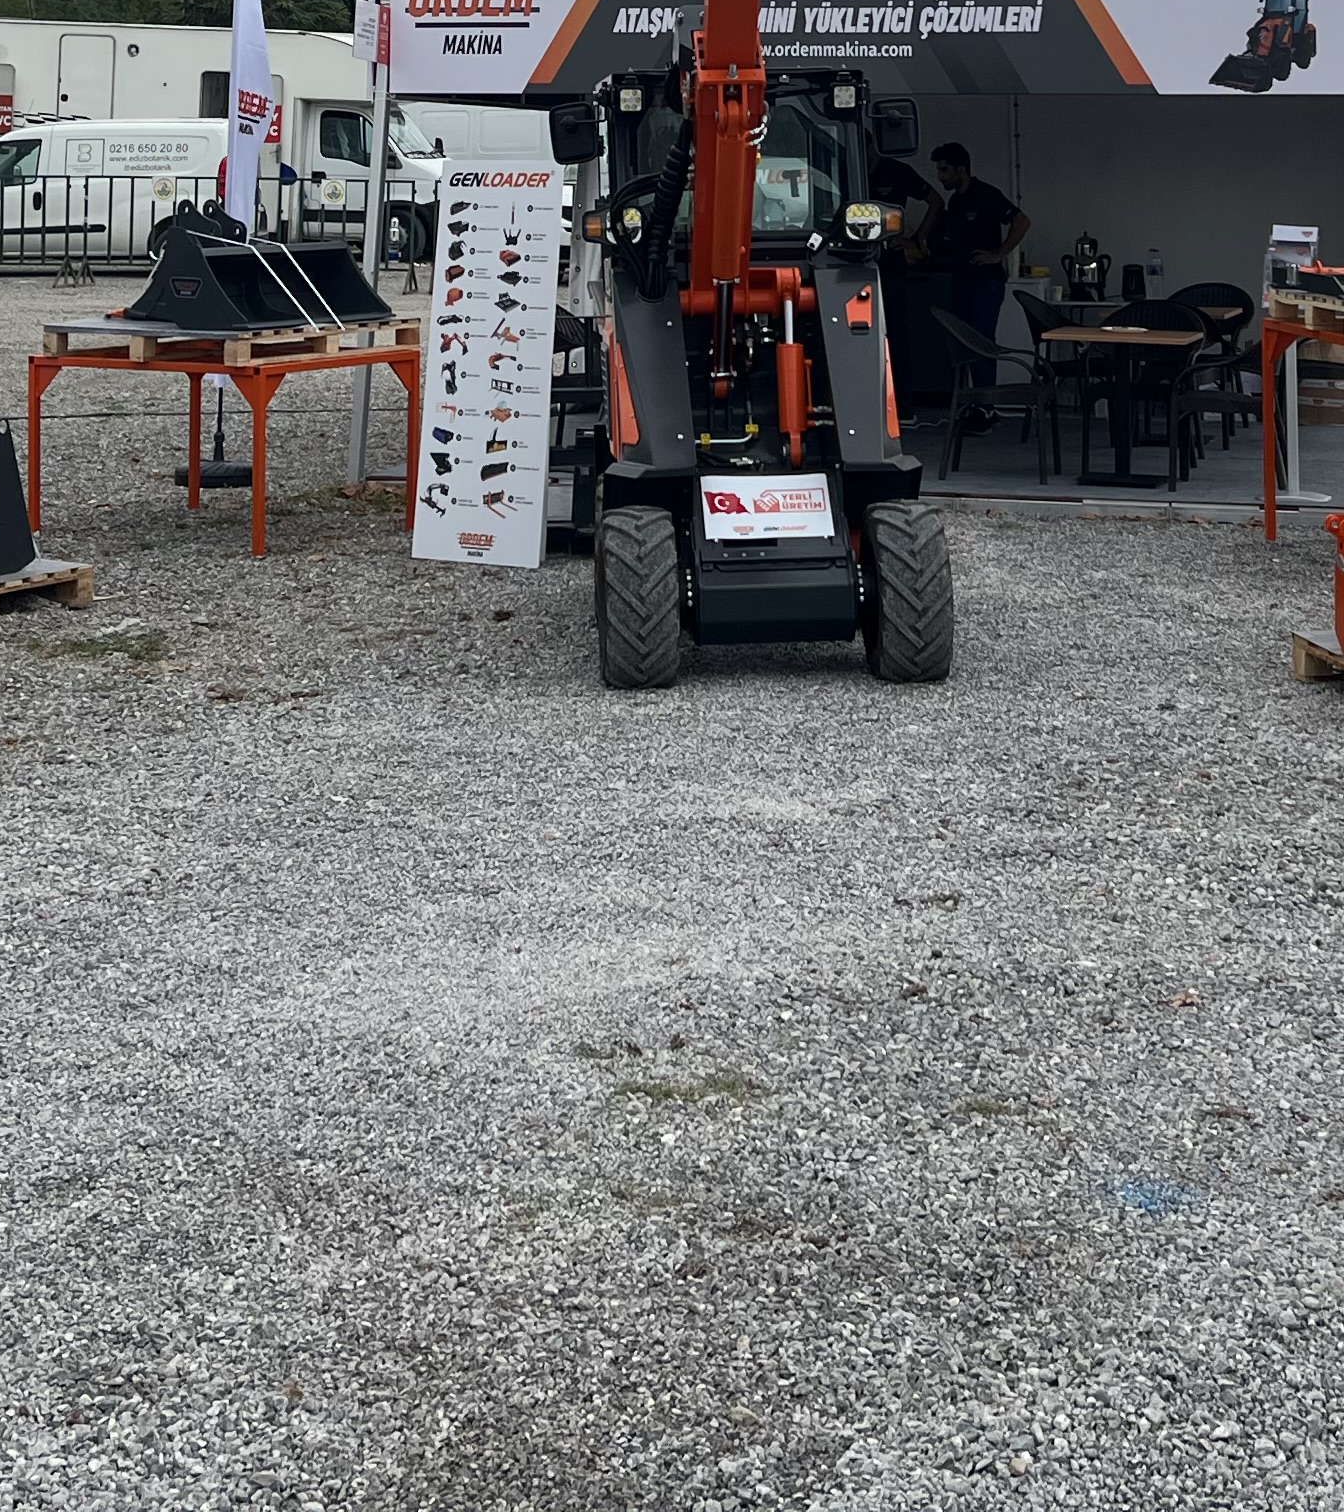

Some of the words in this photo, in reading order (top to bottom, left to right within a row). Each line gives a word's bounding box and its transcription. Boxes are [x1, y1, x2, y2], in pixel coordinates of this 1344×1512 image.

[613, 7, 676, 38] ATAŞM
[804, 1, 914, 34] YÜKLEYİCİ
[918, 0, 1043, 38] ÇÖZÜMLERİ
[443, 30, 502, 56] MAKİNA
[760, 41, 913, 58] w.ordemmakina.com
[109, 144, 134, 153] 0216
[138, 144, 156, 153] 650
[160, 144, 172, 152] 20
[175, 144, 188, 152] 80
[449, 172, 550, 188] GENLOADER
